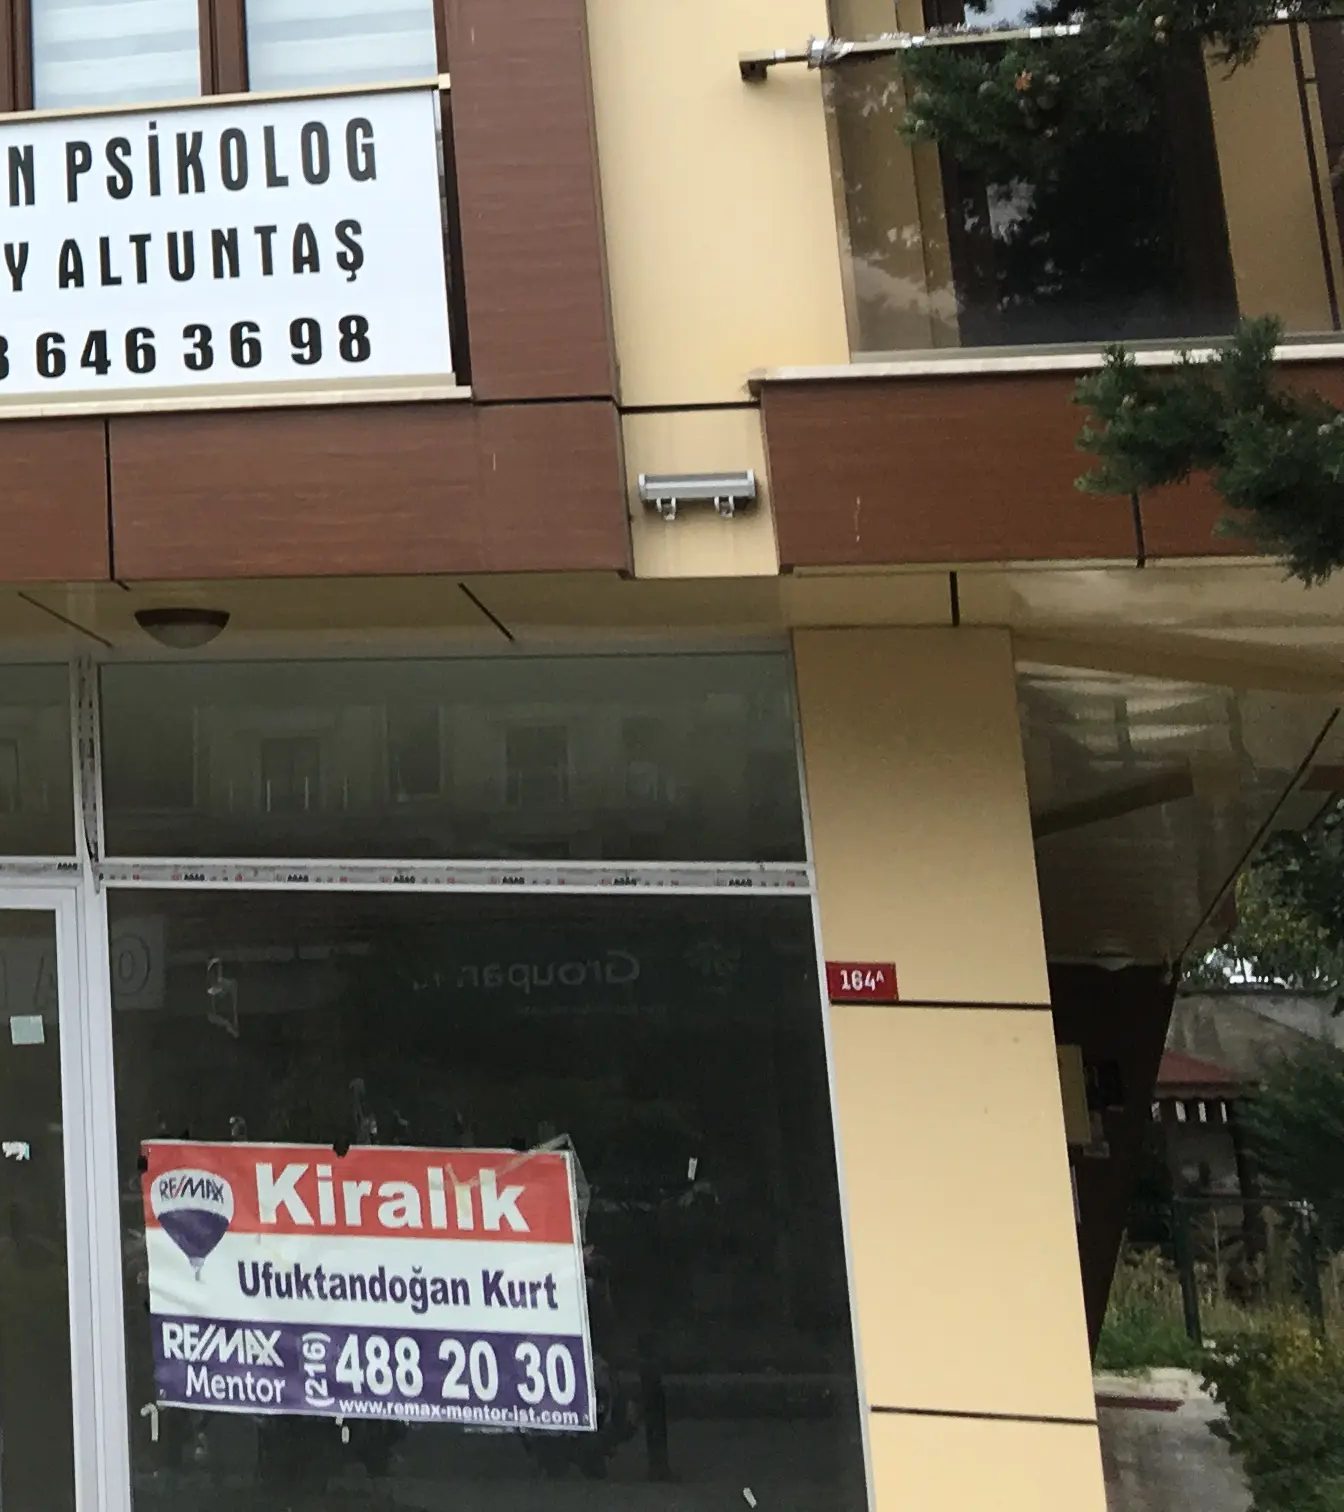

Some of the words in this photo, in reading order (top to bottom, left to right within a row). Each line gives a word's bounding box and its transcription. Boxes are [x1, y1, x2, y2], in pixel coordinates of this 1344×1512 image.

[66, 117, 377, 203] PSİKOLOG
[58, 219, 365, 289] ALTUNTAŞ
[36, 327, 157, 379] 646
[183, 321, 262, 371] 36
[289, 315, 372, 365] 98
[158, 1176, 225, 1205] RE/MAX
[255, 1161, 530, 1233] Kiralık
[238, 1260, 470, 1314] Ufuktandoğan
[482, 1269, 558, 1311] Kurt
[162, 1322, 283, 1368] RE/MAX
[302, 1331, 335, 1408] (216)
[336, 1333, 424, 1397] 488
[438, 1338, 499, 1401] 20
[514, 1342, 576, 1406] 30
[185, 1365, 285, 1404] Mentor
[339, 1399, 579, 1425] www.remax-mentor-ist.com
